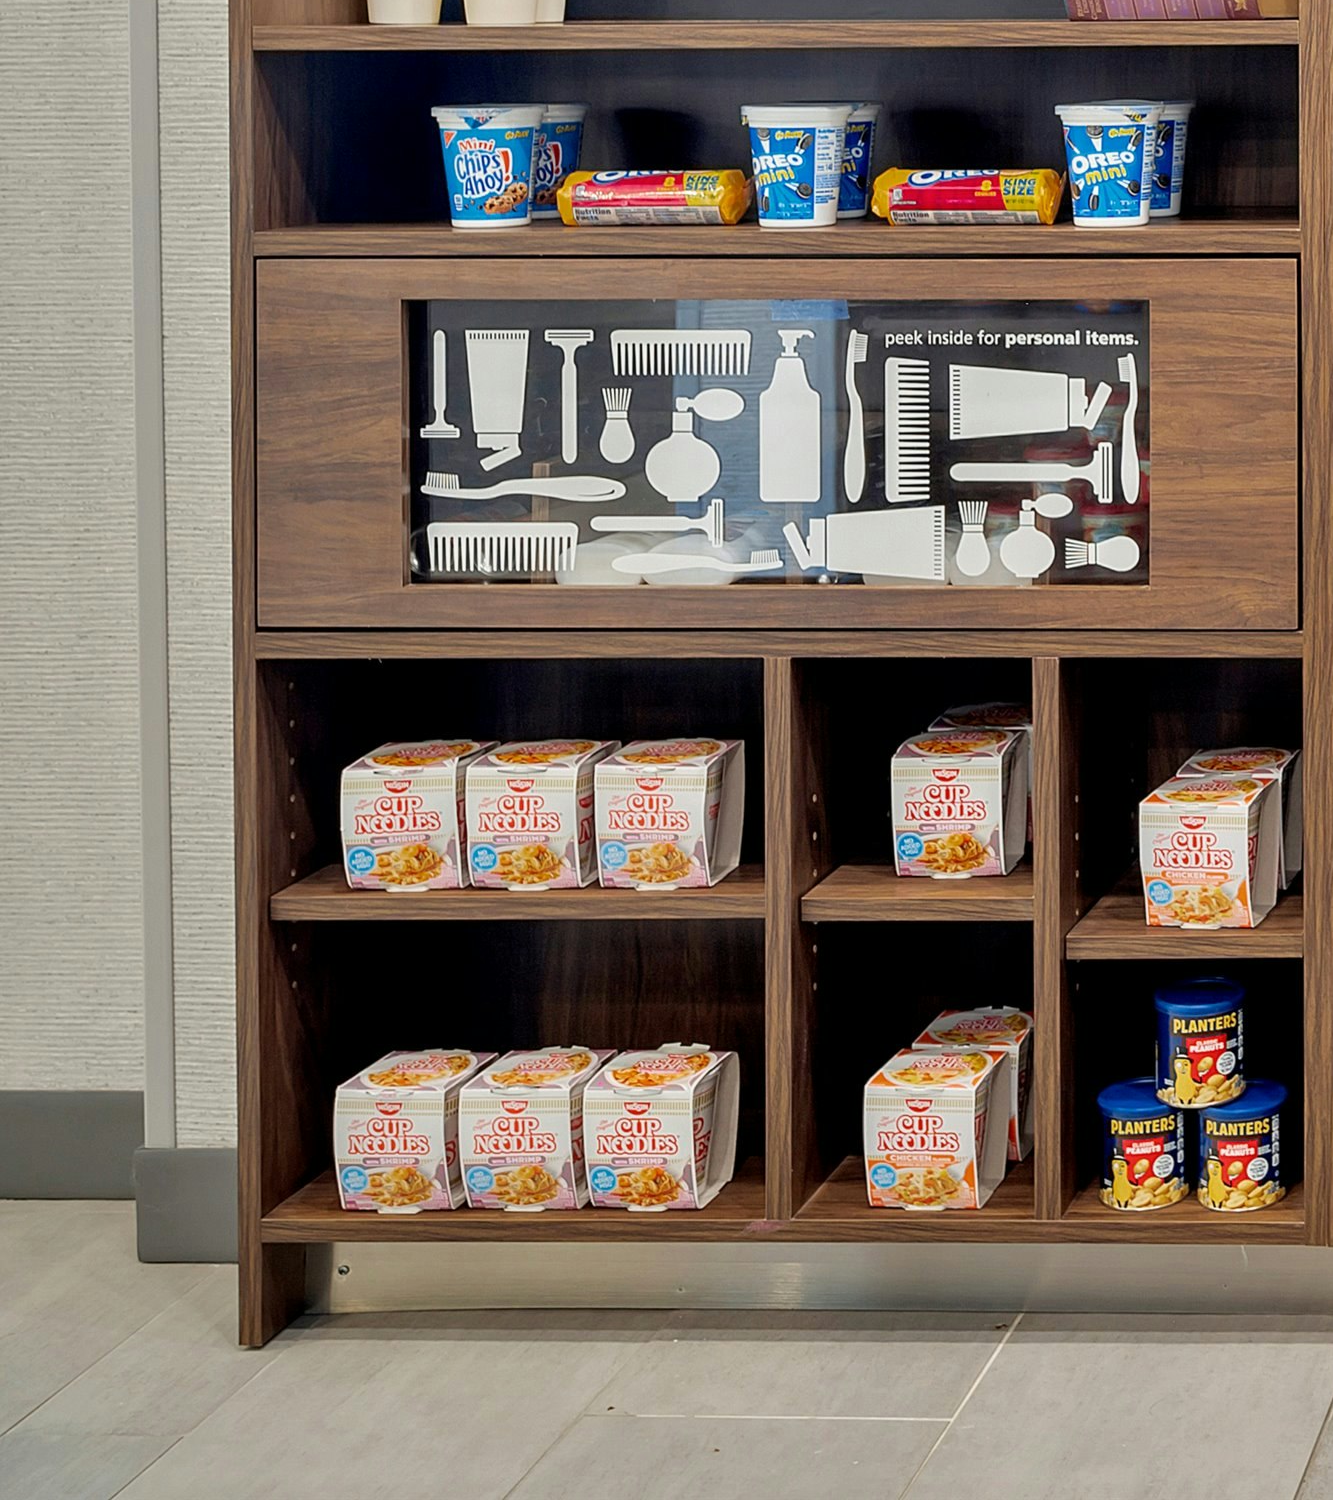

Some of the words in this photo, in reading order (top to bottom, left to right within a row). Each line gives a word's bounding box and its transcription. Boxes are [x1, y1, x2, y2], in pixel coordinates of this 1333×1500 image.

[459, 139, 494, 151] Mini
[456, 154, 500, 181] Chips
[753, 153, 802, 177] OREO
[1071, 151, 1134, 175] OREO
[758, 168, 794, 188] mini
[1004, 178, 1036, 187] KING
[1086, 166, 1127, 186] mini
[1004, 187, 1034, 196] SIZE
[885, 329, 925, 350] peek
[928, 329, 974, 346] inside
[978, 329, 1002, 346] for
[1005, 329, 1082, 350] personal
[1086, 329, 1139, 346] items.
[627, 795, 674, 813] CUP
[924, 785, 970, 803] CUP
[374, 796, 423, 815] CUP
[497, 795, 544, 814] CUP
[905, 801, 986, 821] NOODLES
[355, 811, 441, 834] NOODLES
[479, 811, 561, 833] NOODLES
[607, 810, 690, 831] NOODLES
[936, 823, 972, 831] SHRIMP
[388, 834, 431, 843] SHRIMP
[510, 834, 546, 842] SHRIMP
[639, 833, 675, 842] SHRIMP
[1171, 832, 1217, 852] CUP
[1153, 847, 1233, 869] NOODLES
[1166, 871, 1206, 879] CHICKEN
[1173, 1012, 1237, 1034] PLANTERS
[1190, 1043, 1224, 1054] PEANUTS
[366, 1118, 413, 1138] CUP
[492, 1117, 540, 1137] CUP
[614, 1117, 662, 1137] CUP
[896, 1115, 942, 1135] CUP
[1111, 1115, 1176, 1136] PLANTERS
[1206, 1118, 1270, 1136] PLANTERS
[348, 1133, 431, 1156] NOODLES
[473, 1133, 557, 1155] NOODLES
[597, 1133, 679, 1155] NOODLES
[877, 1131, 960, 1153] NOODLES
[1126, 1145, 1162, 1155] PEANUTS
[1220, 1147, 1256, 1157] PEANUTS
[379, 1157, 414, 1165] SHRIMP
[506, 1156, 542, 1165] SHRIMP
[628, 1157, 664, 1165] SHRIMP
[890, 1154, 932, 1163] CHICKEN
